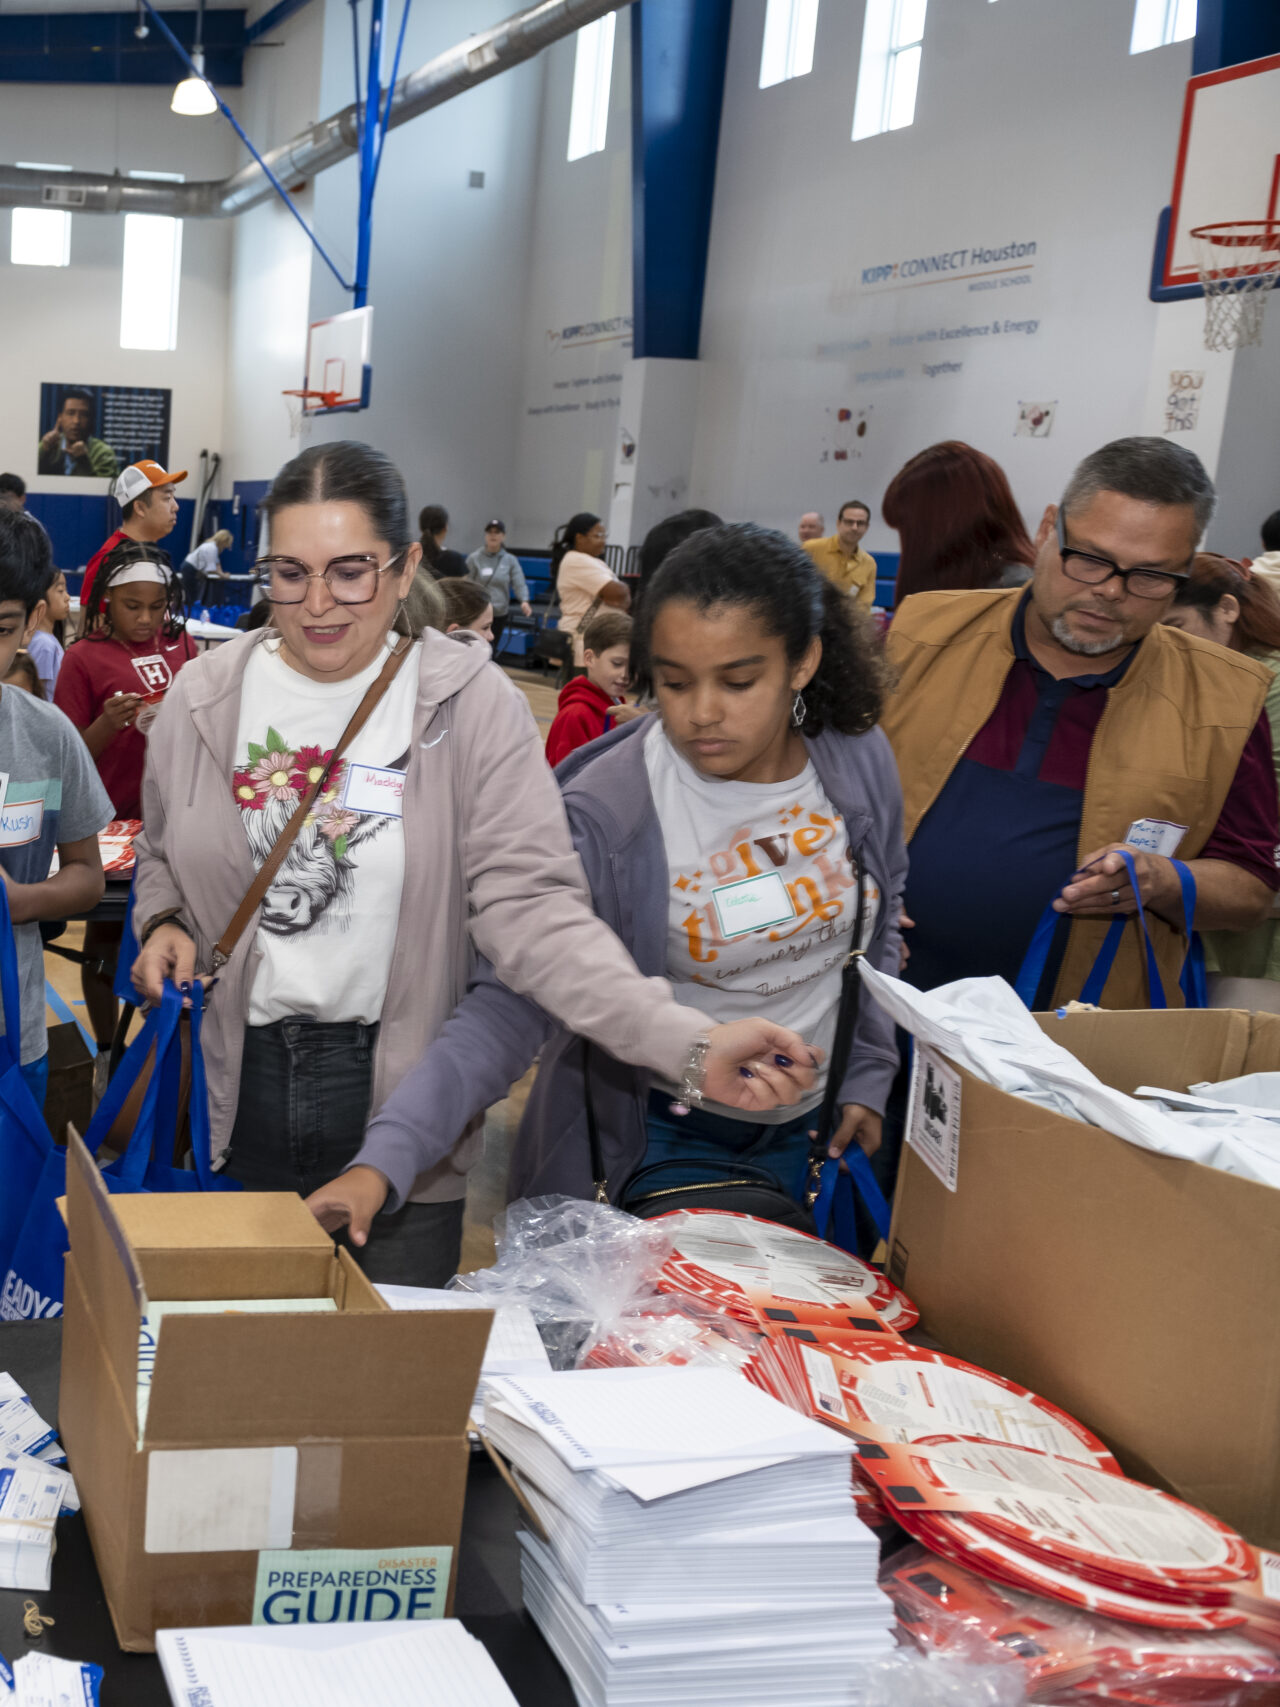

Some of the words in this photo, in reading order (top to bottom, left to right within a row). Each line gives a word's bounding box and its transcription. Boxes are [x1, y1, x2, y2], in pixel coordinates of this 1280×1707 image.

[900, 250, 969, 278] CONNECT
[971, 241, 1037, 265] Houston
[999, 274, 1032, 288] SCHOOL
[939, 322, 991, 340] Excellence
[992, 321, 1002, 334] &
[1003, 319, 1040, 335] Energy
[143, 664, 167, 685] H
[709, 813, 842, 885] give
[753, 938, 813, 968] every
[0, 1268, 52, 1320] EADY
[378, 1557, 437, 1570] DISASTER
[268, 1569, 437, 1588] PREPAREDNESS
[262, 1587, 437, 1625] GUIDE
